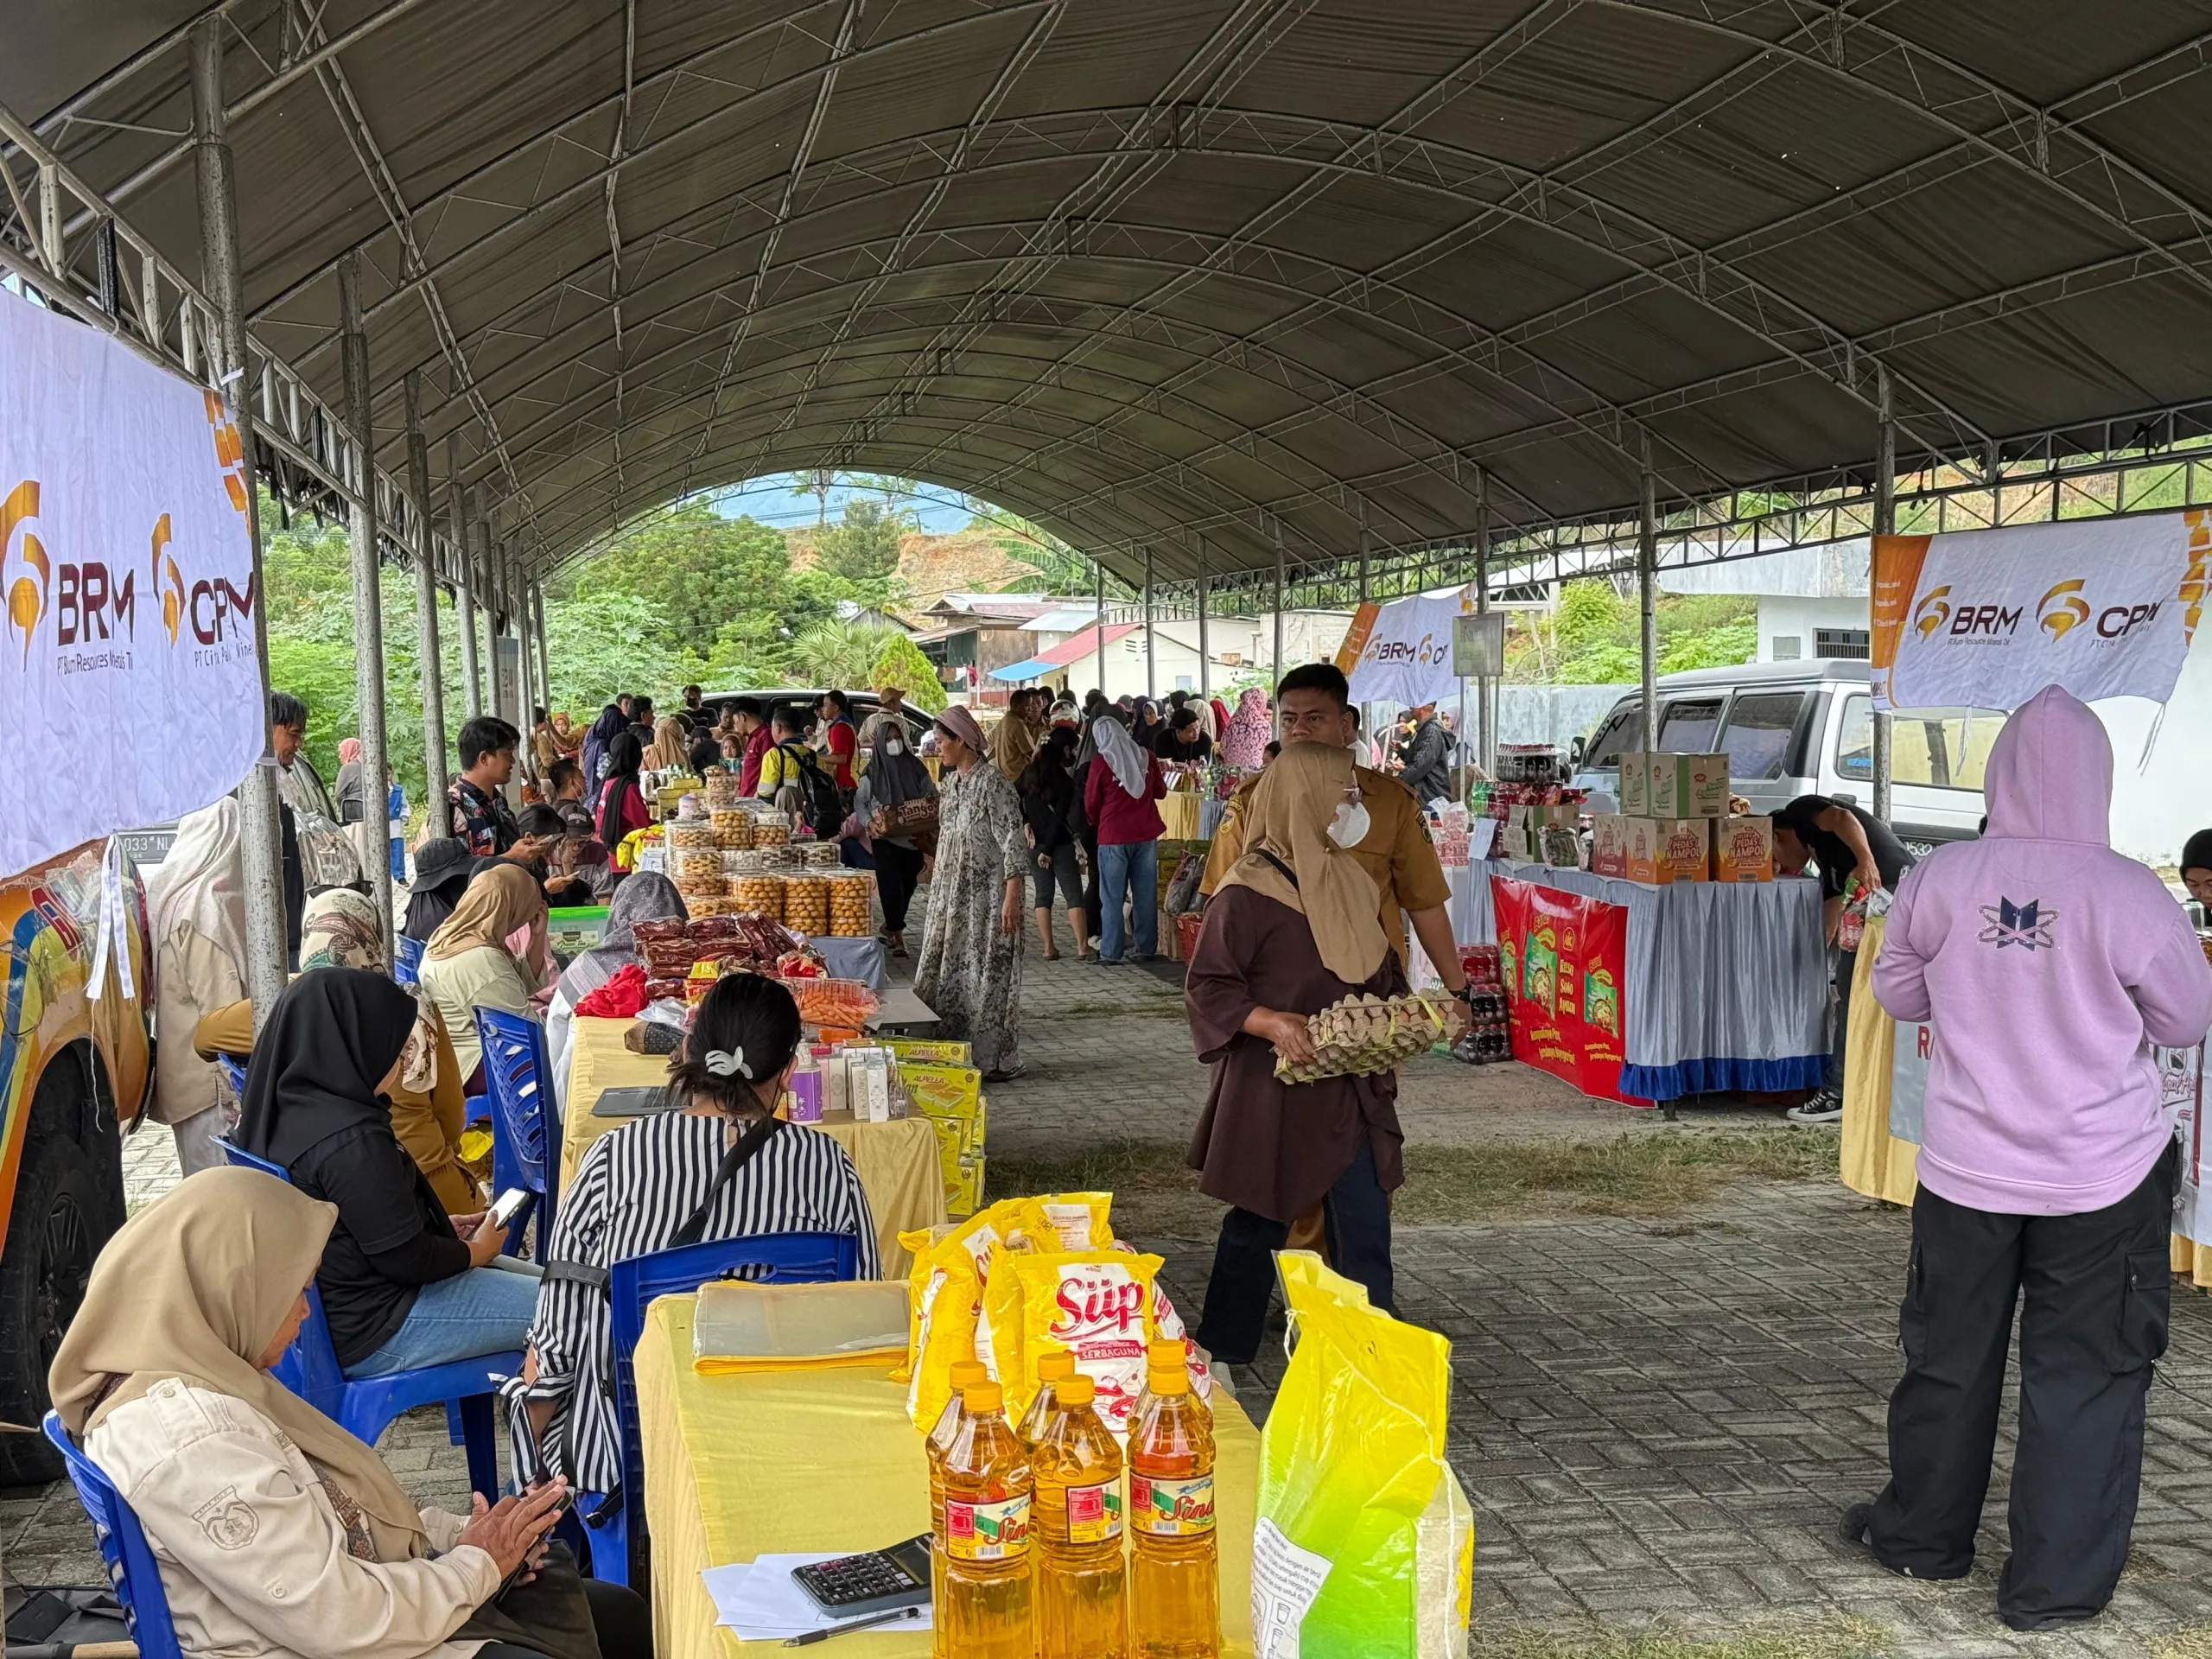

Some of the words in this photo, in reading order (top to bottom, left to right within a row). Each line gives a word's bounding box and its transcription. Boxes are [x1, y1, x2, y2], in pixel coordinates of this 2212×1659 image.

[58, 562, 135, 646] BRM
[190, 572, 254, 645] CPM
[1950, 606, 2024, 635] BRM
[194, 651, 201, 668] PT
[236, 641, 253, 659] Mine
[1378, 642, 1416, 663] BRM
[898, 803, 936, 818] Tango
[1672, 839, 1694, 849] PEDAS
[1729, 846, 1764, 859] NAMPOL
[1736, 838, 1758, 849] PEDAS
[1666, 847, 1701, 861] NAMPOL
[1558, 996, 1576, 1015] Ayam
[1917, 1025, 1936, 1061] R
[1082, 1347, 1141, 1360] SERBAGUNA
